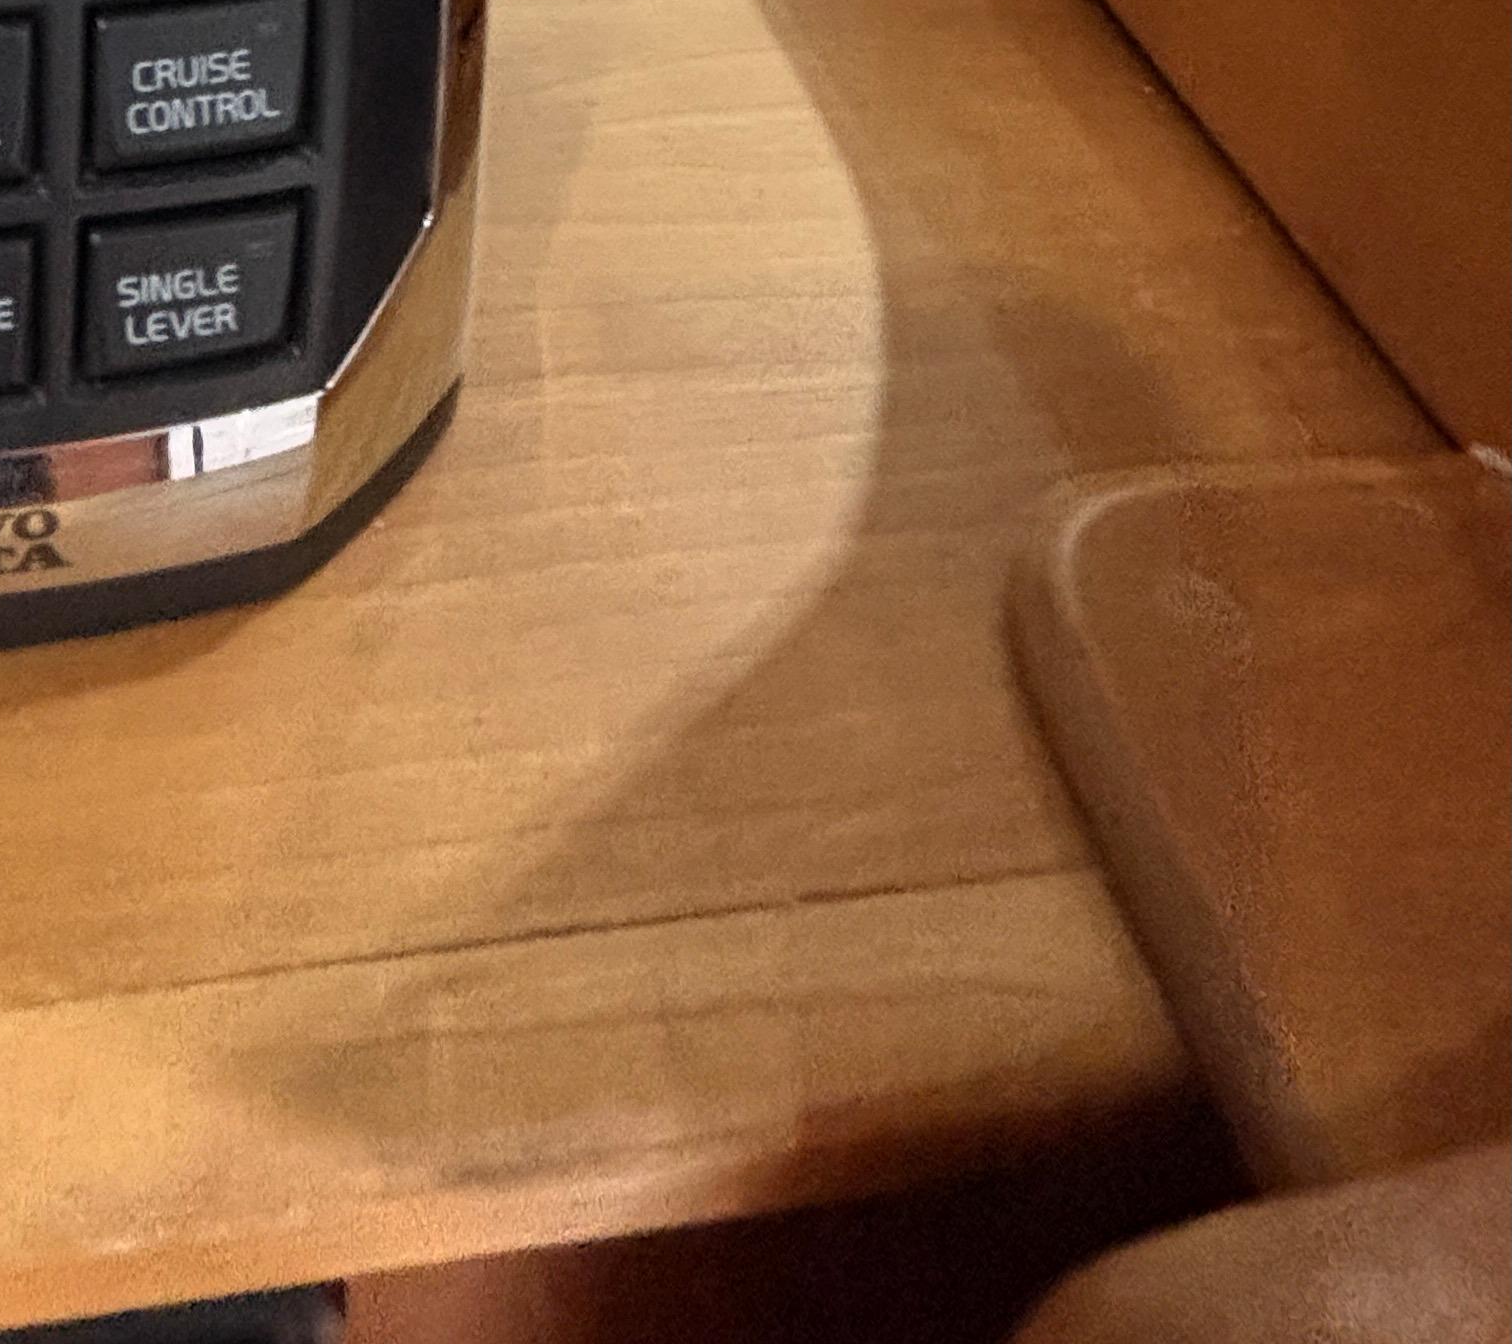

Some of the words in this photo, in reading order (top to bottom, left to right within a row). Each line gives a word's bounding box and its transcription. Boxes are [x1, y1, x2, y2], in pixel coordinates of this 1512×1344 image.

[132, 48, 252, 93] CRUISE
[126, 88, 281, 135] CONTROL
[116, 263, 240, 308] SINGLE
[126, 302, 239, 345] LEVER
